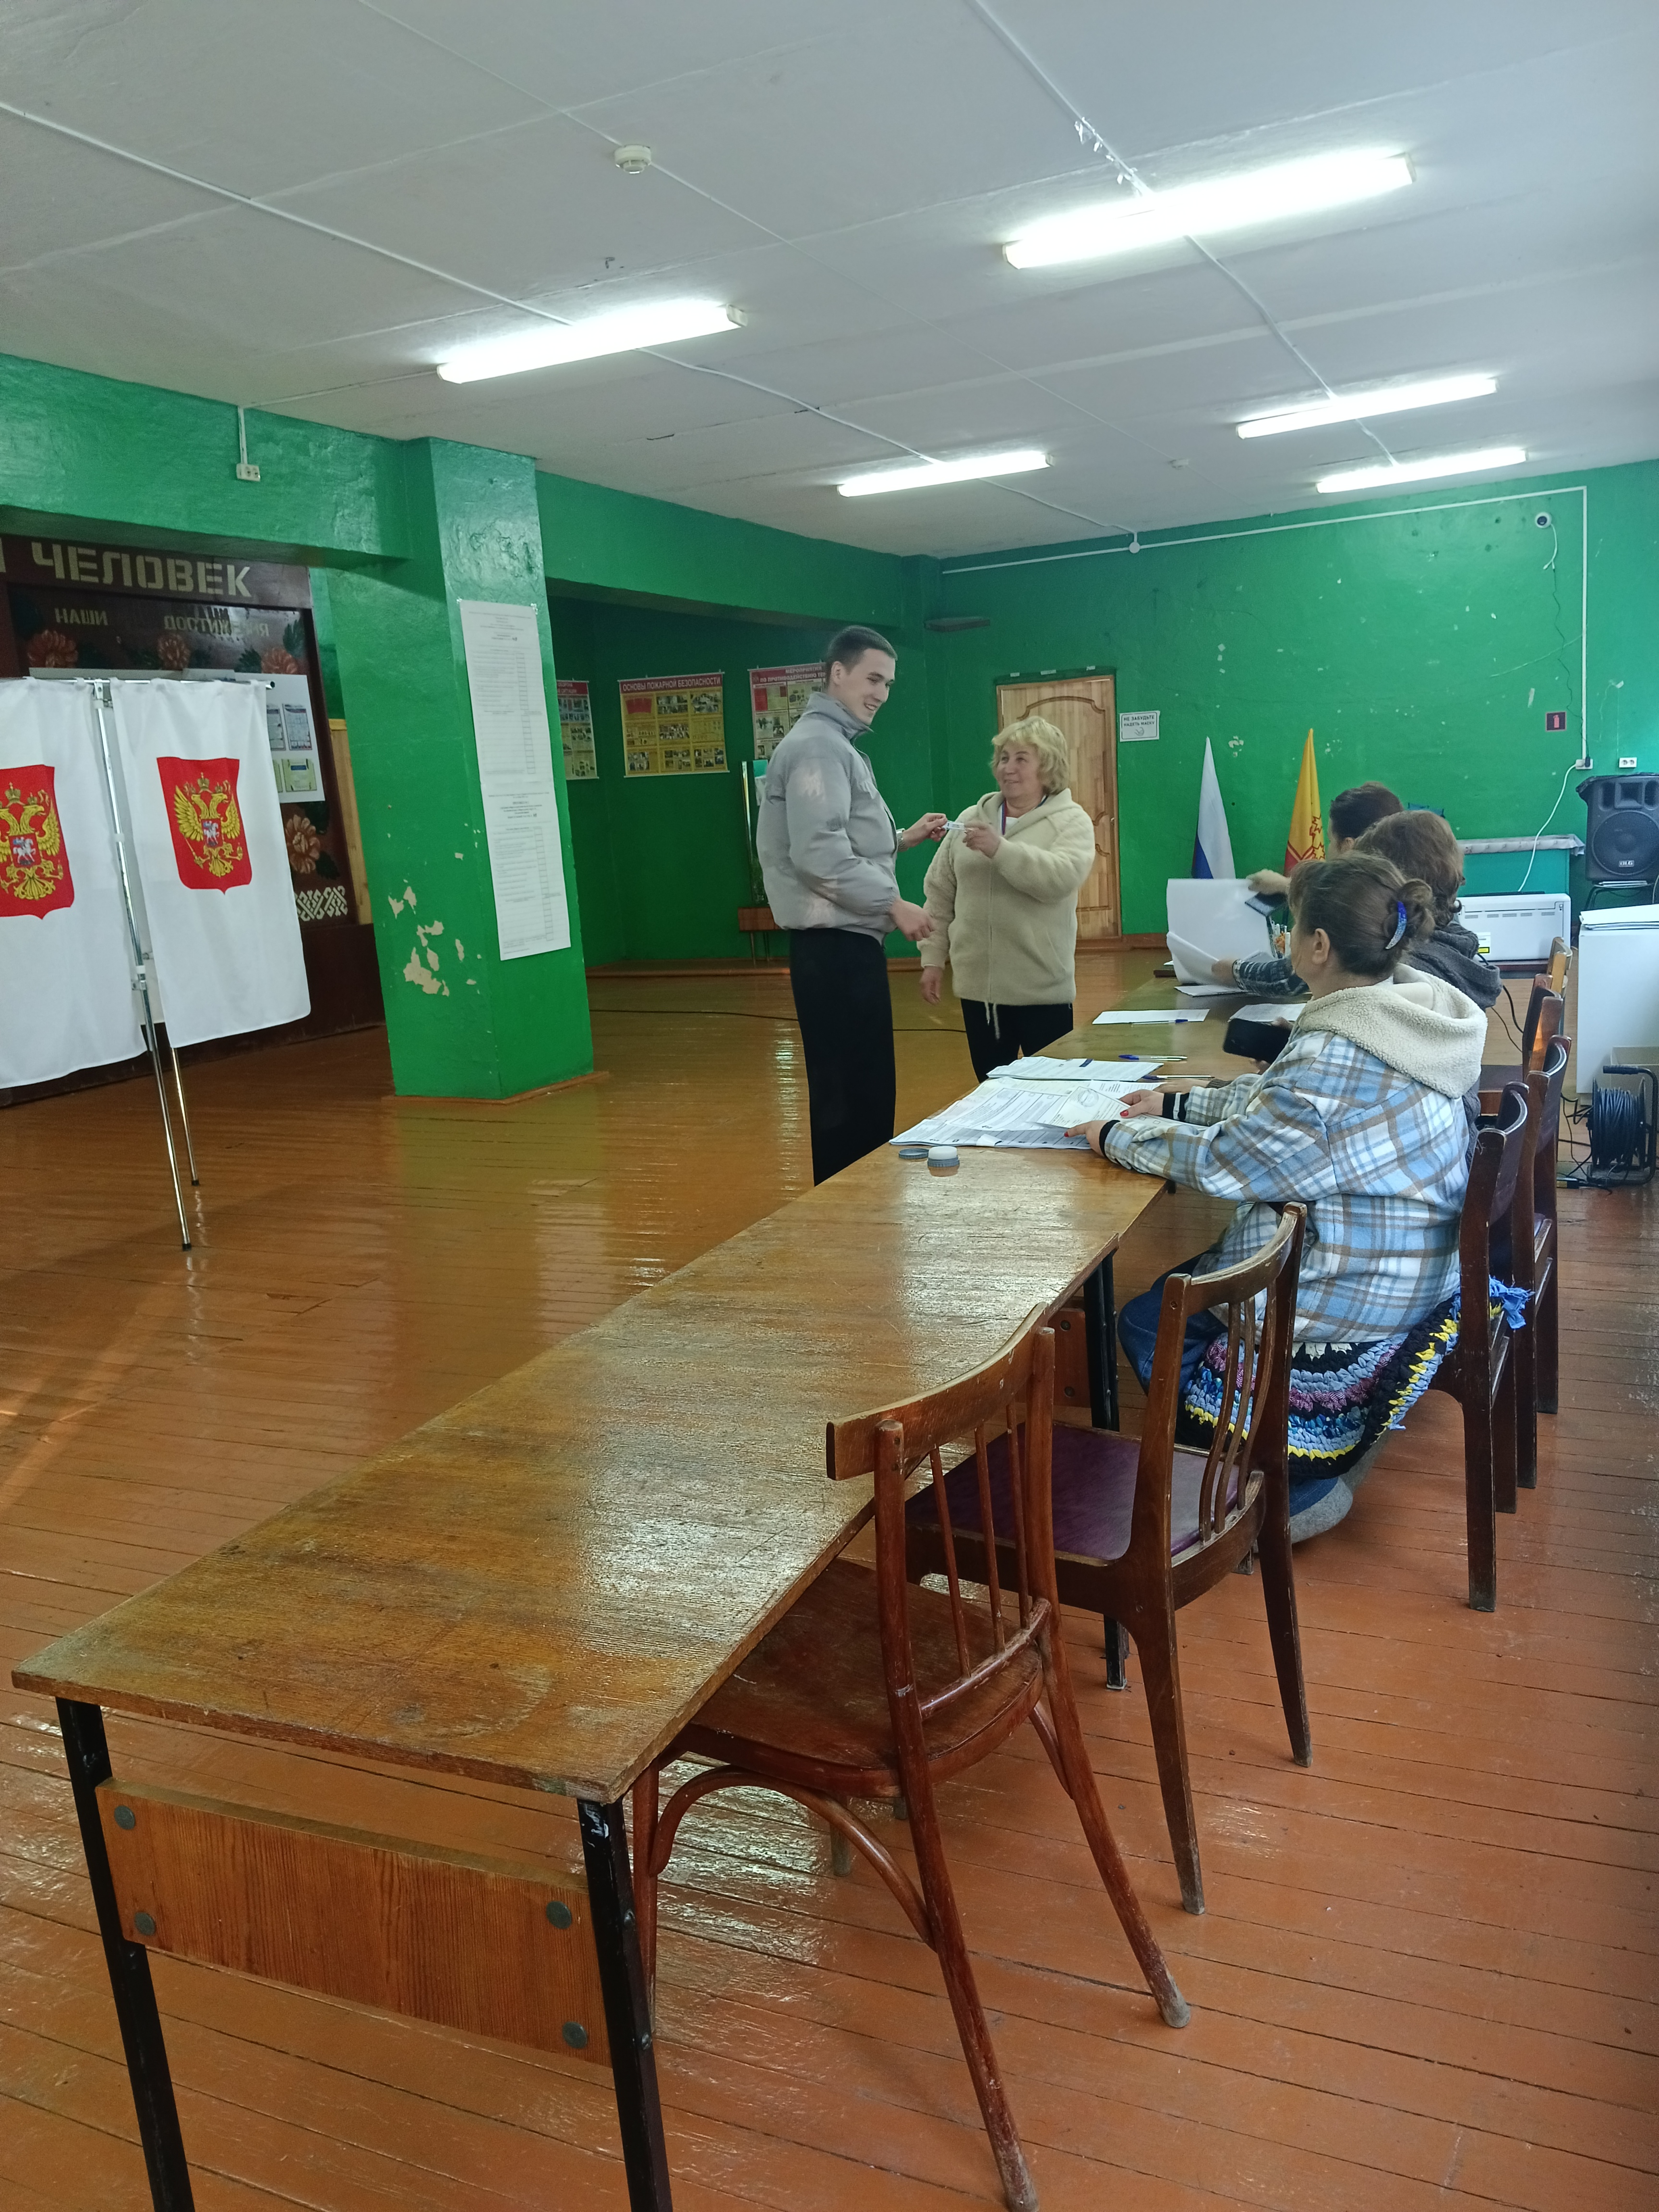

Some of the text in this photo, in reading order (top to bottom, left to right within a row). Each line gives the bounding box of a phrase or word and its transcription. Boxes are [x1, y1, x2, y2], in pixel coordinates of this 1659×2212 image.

[31, 541, 252, 598] ЧЕЛОВЕК
[54, 608, 270, 637] НАШИ ДОСТИЖЕЯ
[623, 676, 720, 691] ОСНОВЫ ПОЖАРНОЙ БЕЗОПАСНОСТИ
